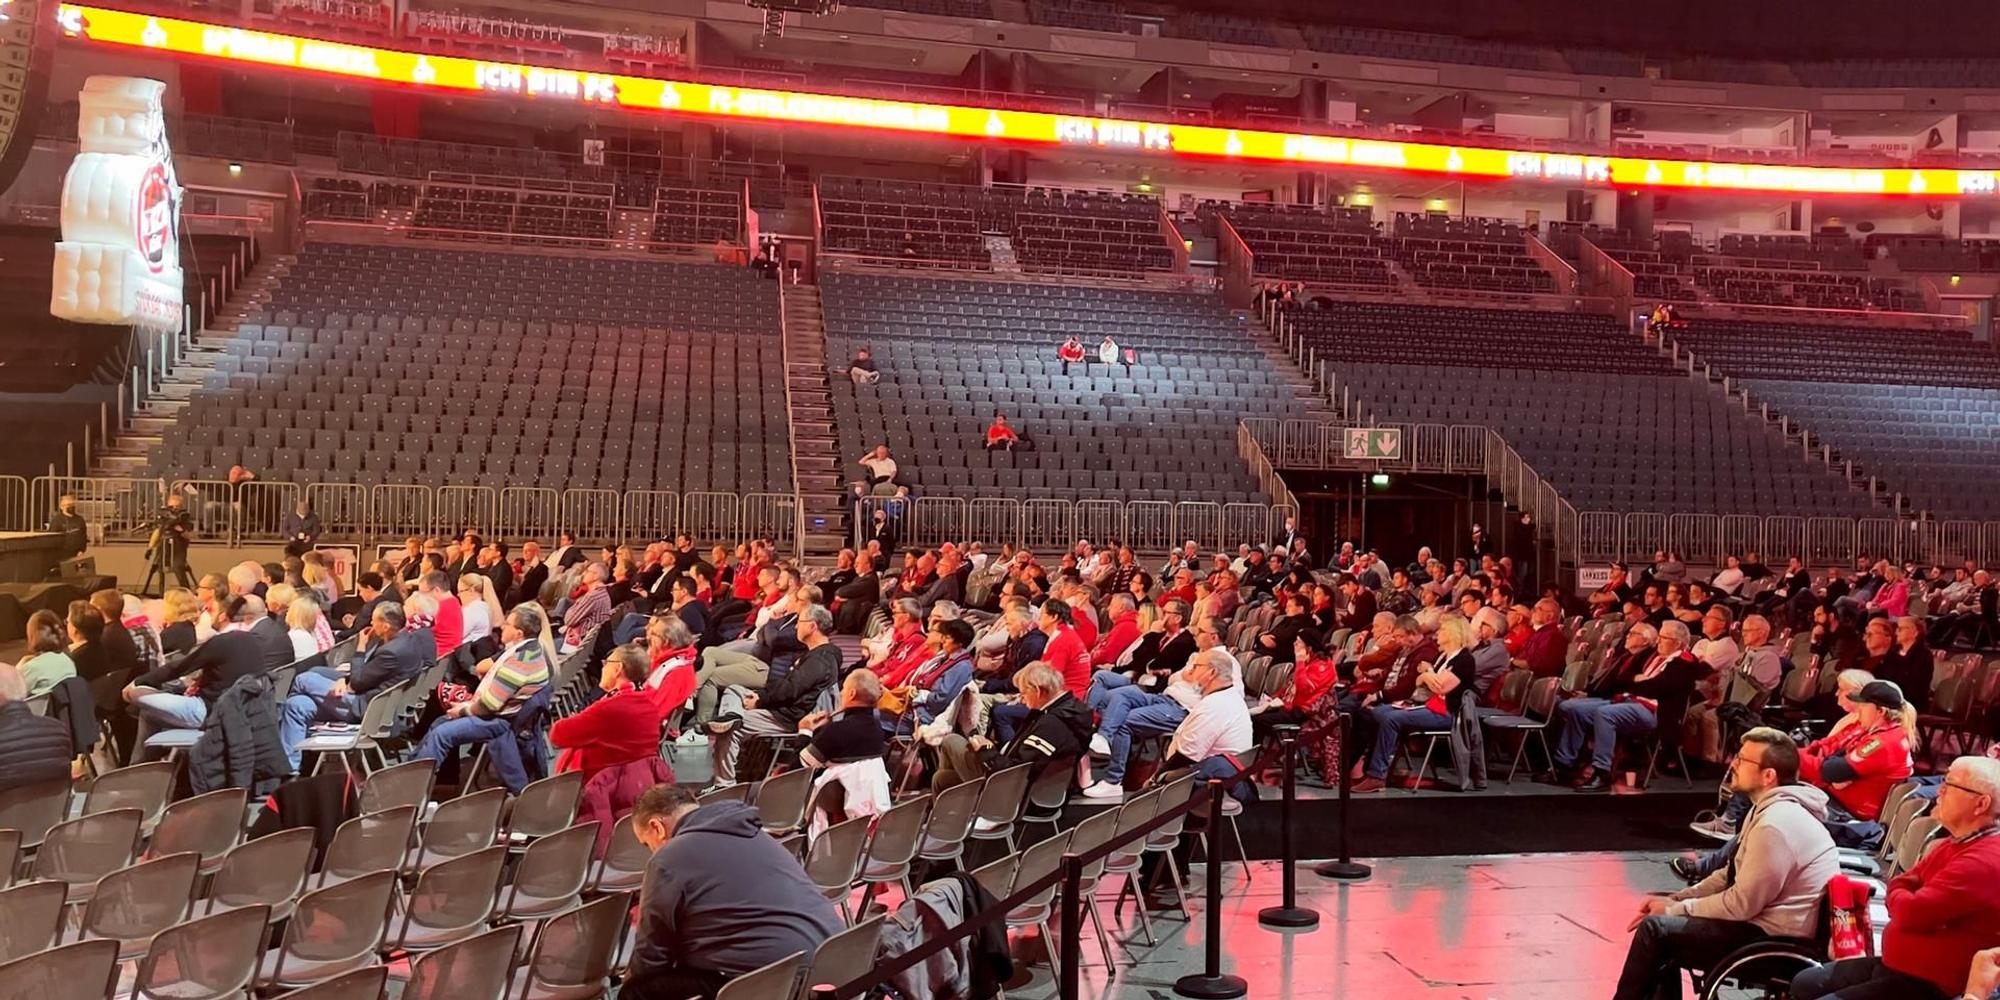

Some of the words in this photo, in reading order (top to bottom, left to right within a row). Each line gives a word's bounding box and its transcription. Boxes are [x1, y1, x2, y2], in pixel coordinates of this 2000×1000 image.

[477, 66, 521, 90] ICH
[528, 71, 578, 95] BIN
[584, 76, 613, 99] FC
[1057, 120, 1093, 141] ICH
[1098, 124, 1140, 145] BIN
[1145, 128, 1169, 148] FC
[1509, 155, 1541, 175] ICH
